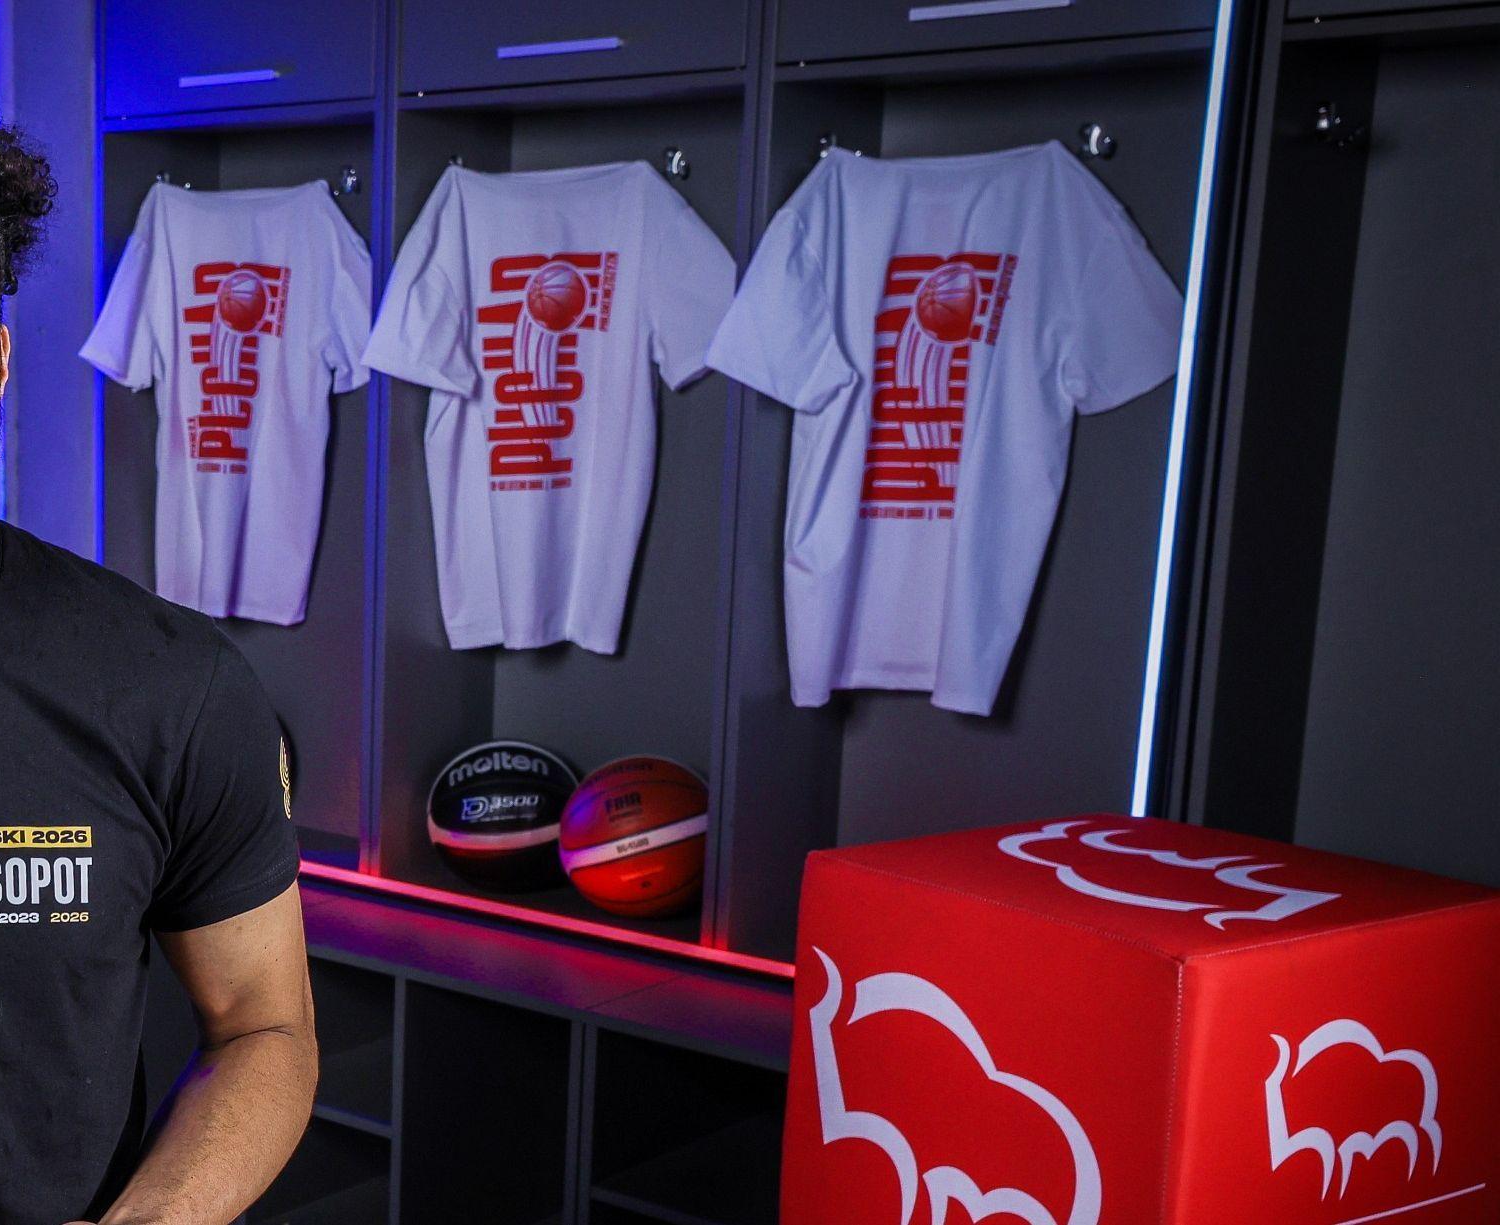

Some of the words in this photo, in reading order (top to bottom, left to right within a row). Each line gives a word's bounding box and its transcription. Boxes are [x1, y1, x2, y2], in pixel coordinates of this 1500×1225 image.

[449, 751, 548, 787] molten
[31, 830, 88, 844] 2026
[50, 911, 89, 923] 2026
